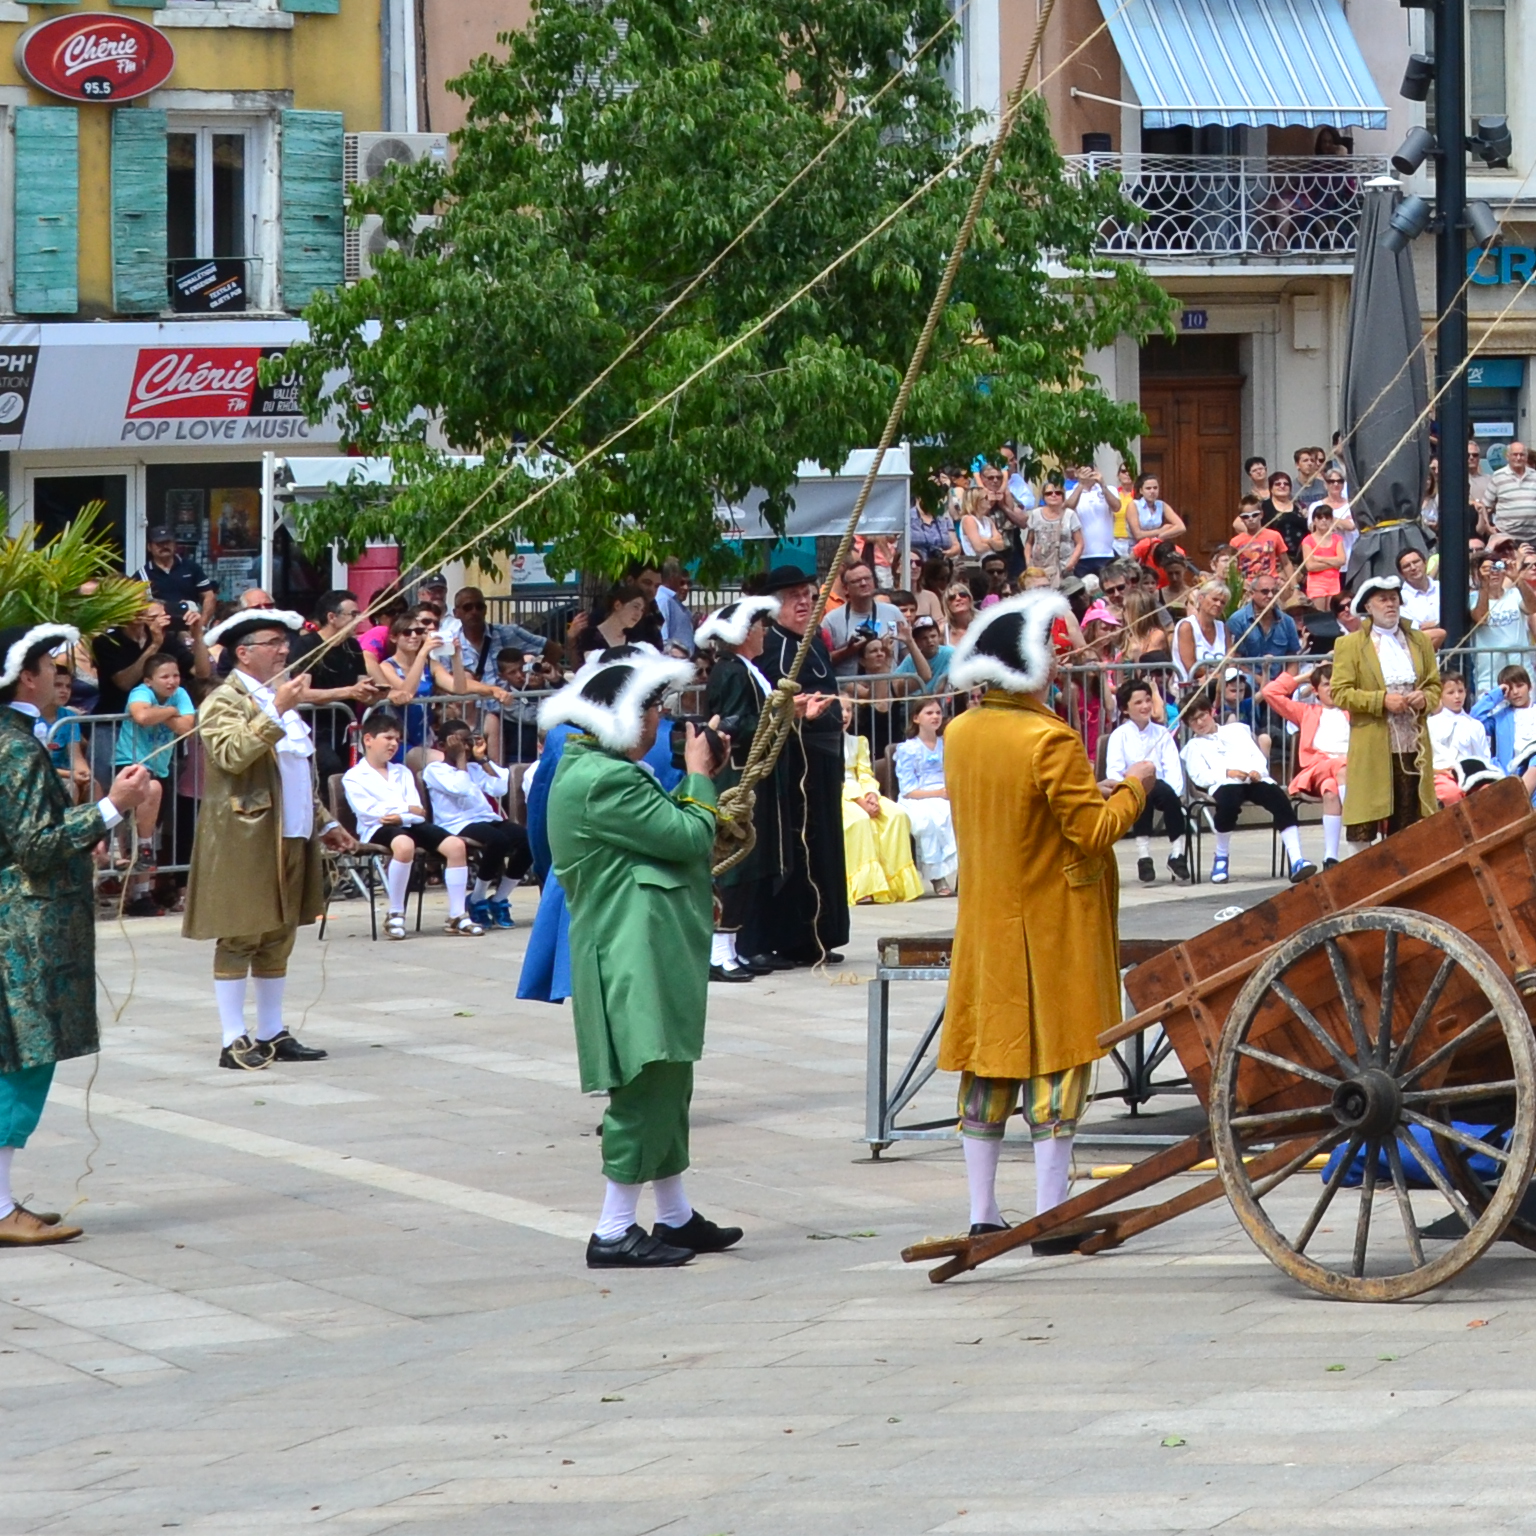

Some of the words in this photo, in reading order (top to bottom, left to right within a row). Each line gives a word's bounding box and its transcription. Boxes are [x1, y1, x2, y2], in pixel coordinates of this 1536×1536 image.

[64, 33, 137, 67] Chérie
[84, 81, 111, 95] 95.5
[1188, 313, 1203, 327] 10
[0, 376, 30, 388] TION
[136, 354, 254, 401] Chérie
[263, 401, 275, 413] DU
[277, 399, 303, 412] RHÔN
[121, 421, 170, 441] POP
[175, 420, 237, 440] LOVE
[242, 419, 309, 439] MUSIC
